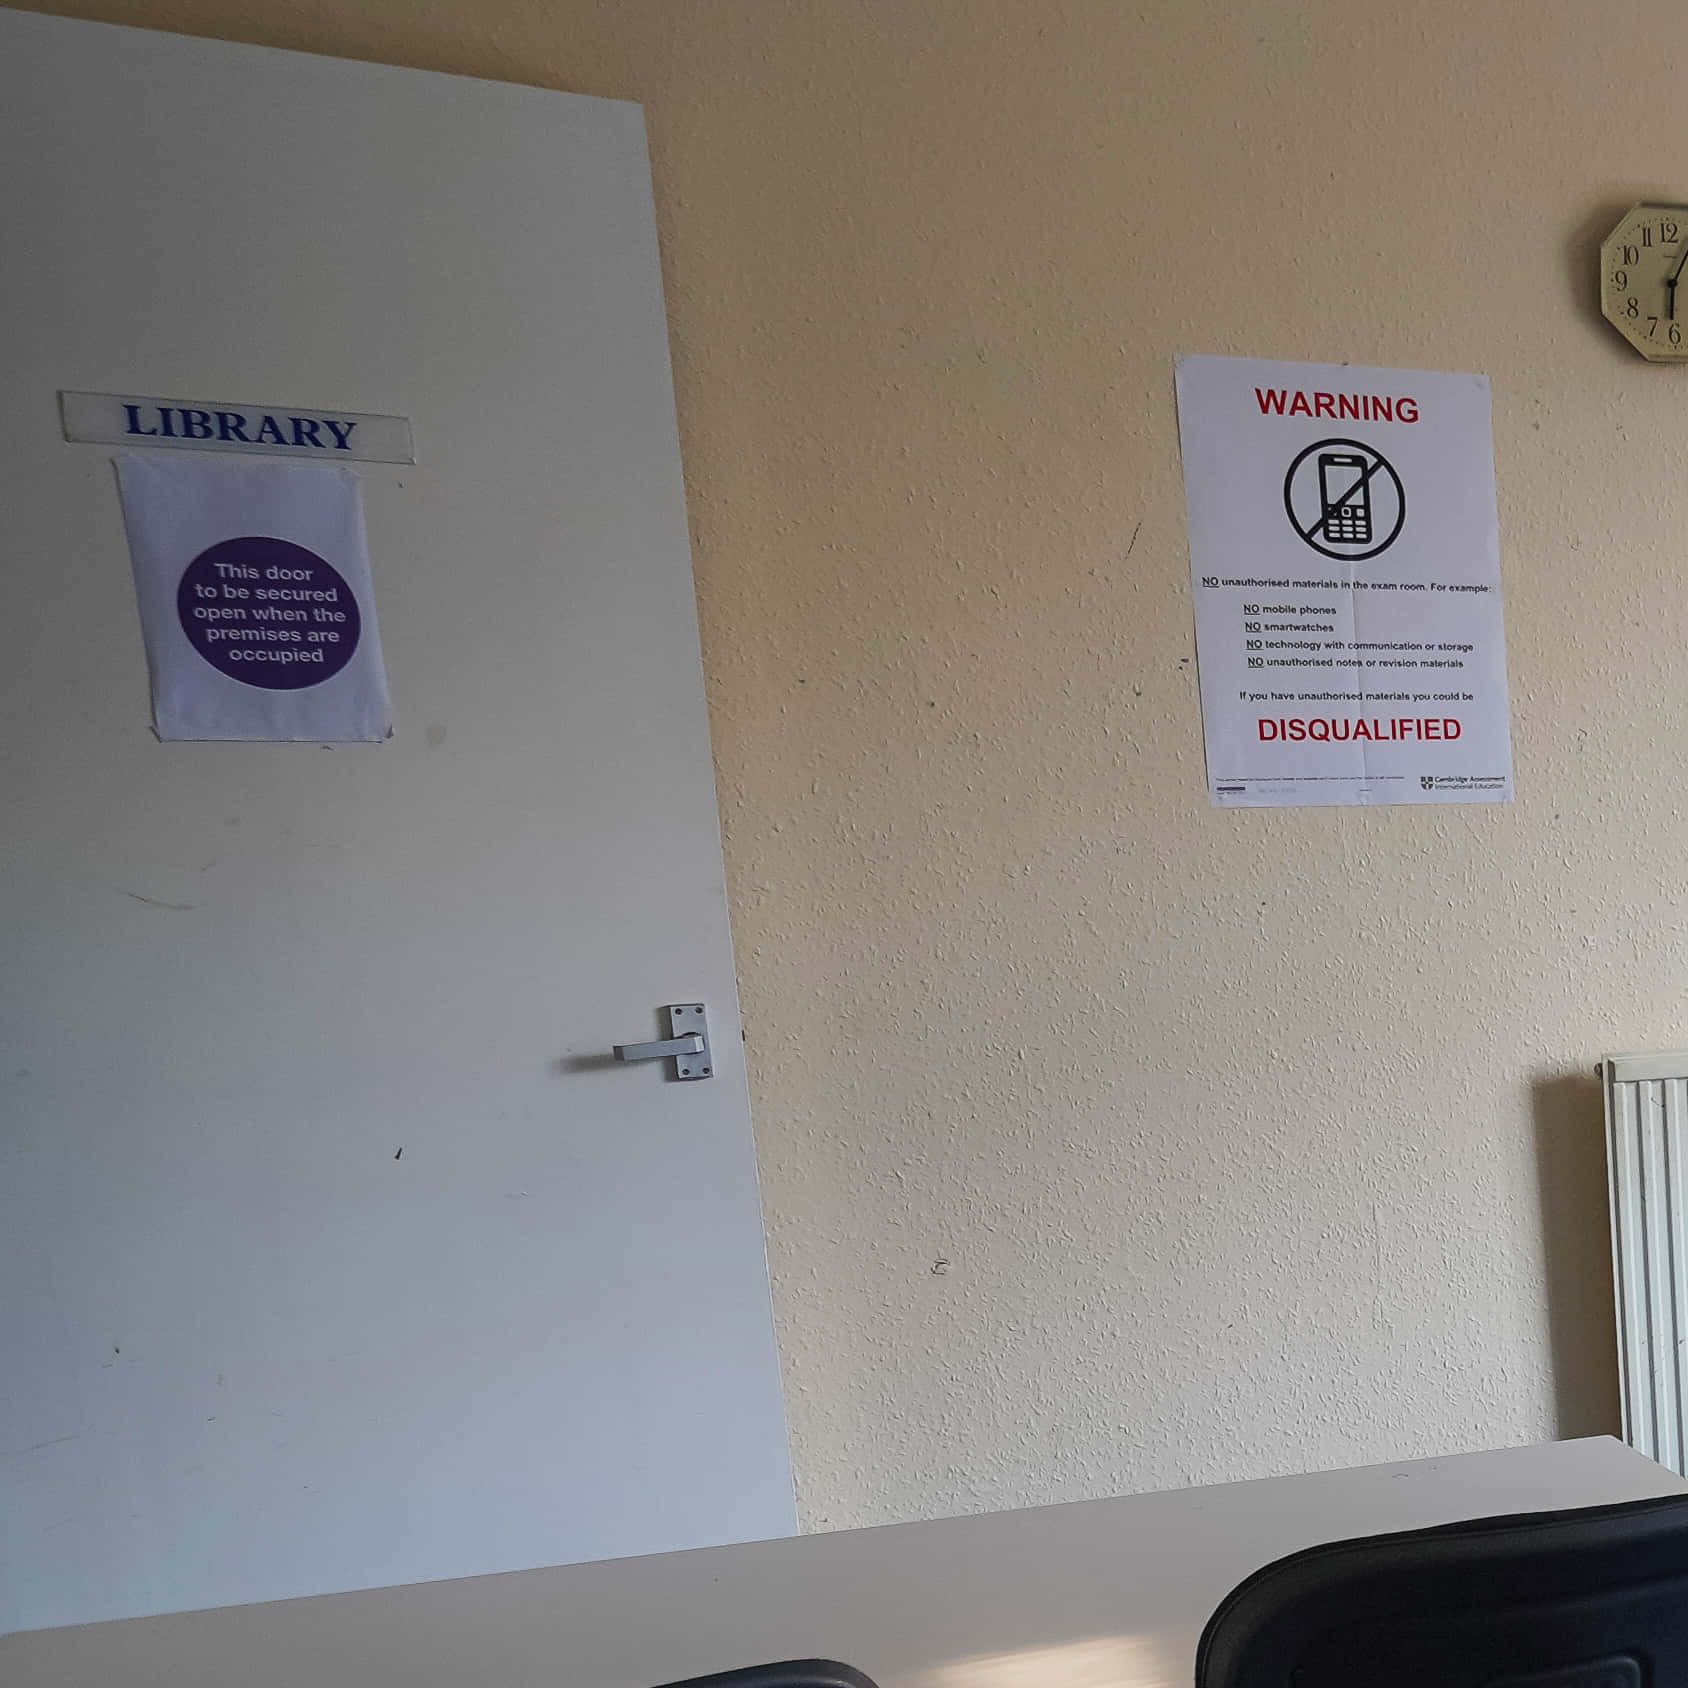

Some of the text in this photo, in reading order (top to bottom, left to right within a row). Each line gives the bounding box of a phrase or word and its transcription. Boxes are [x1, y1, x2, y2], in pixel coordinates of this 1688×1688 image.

[1642, 227, 1652, 247] 11
[1659, 223, 1678, 243] 12
[1623, 245, 1639, 265] 10
[1615, 271, 1627, 291] 9
[1627, 297, 1639, 318] 8
[1648, 317, 1658, 336] 7
[1669, 323, 1681, 343] 6
[1255, 388, 1418, 423] WARNING
[122, 404, 357, 450] LIBRARY
[214, 563, 313, 581] This door
[194, 584, 337, 601] to be secured
[1202, 577, 1219, 588] NO
[1221, 578, 1289, 587] unauthorised
[1292, 579, 1338, 589] materials
[1341, 580, 1350, 589] in
[1353, 581, 1368, 590] the
[1371, 583, 1397, 591] exam
[1431, 583, 1446, 591] For
[194, 606, 346, 622] open when the
[1243, 604, 1337, 616] NO mobile phones
[207, 626, 340, 643] premises are
[1245, 622, 1334, 632] NO smartwatches
[1246, 640, 1473, 652] NO technology with communication or storage
[229, 648, 324, 664] occupied
[1248, 657, 1264, 668] NO
[1267, 658, 1333, 667] unauthorised
[1337, 659, 1363, 667] notes
[1379, 659, 1417, 667] revision
[1420, 659, 1464, 668] materials
[1240, 691, 1474, 703] If you have unauthorised materials you could be
[1258, 718, 1461, 742] DISQUALIFIED
